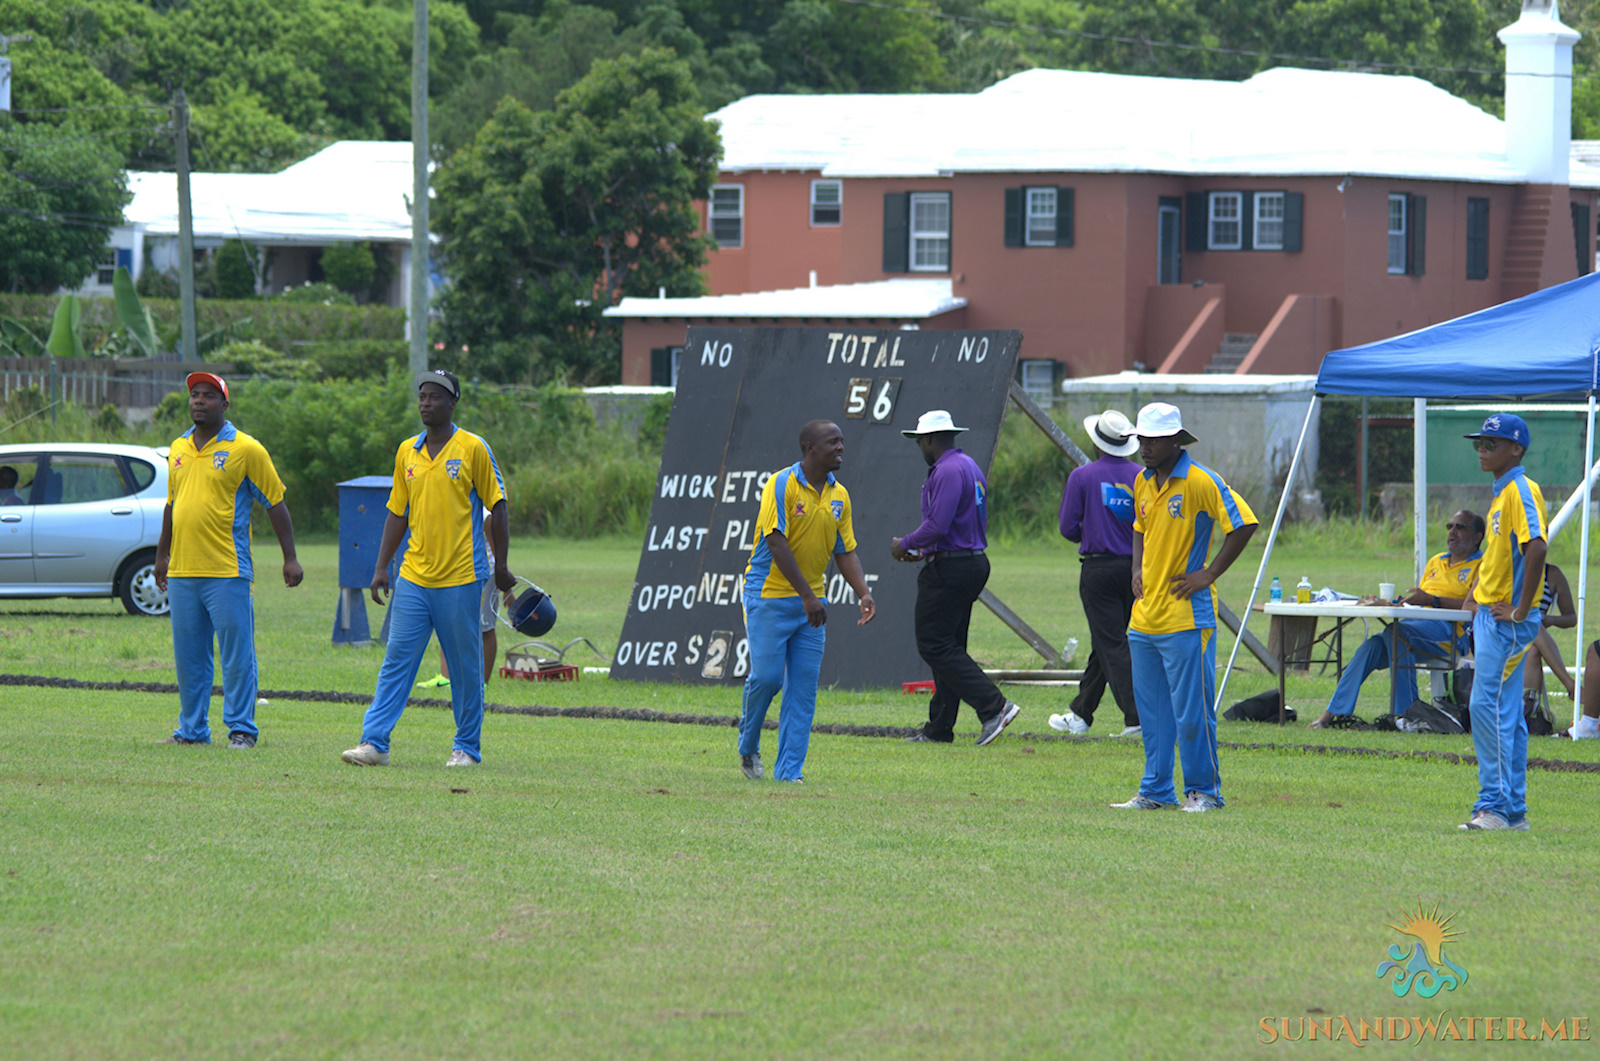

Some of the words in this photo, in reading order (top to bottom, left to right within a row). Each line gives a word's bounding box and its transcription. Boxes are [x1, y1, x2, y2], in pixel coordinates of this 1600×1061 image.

[700, 340, 733, 367] NO
[827, 333, 905, 368] TOTAL
[957, 336, 989, 363] NO
[846, 381, 893, 421] 56
[1109, 498, 1131, 507] BTC
[647, 525, 709, 552] LAST
